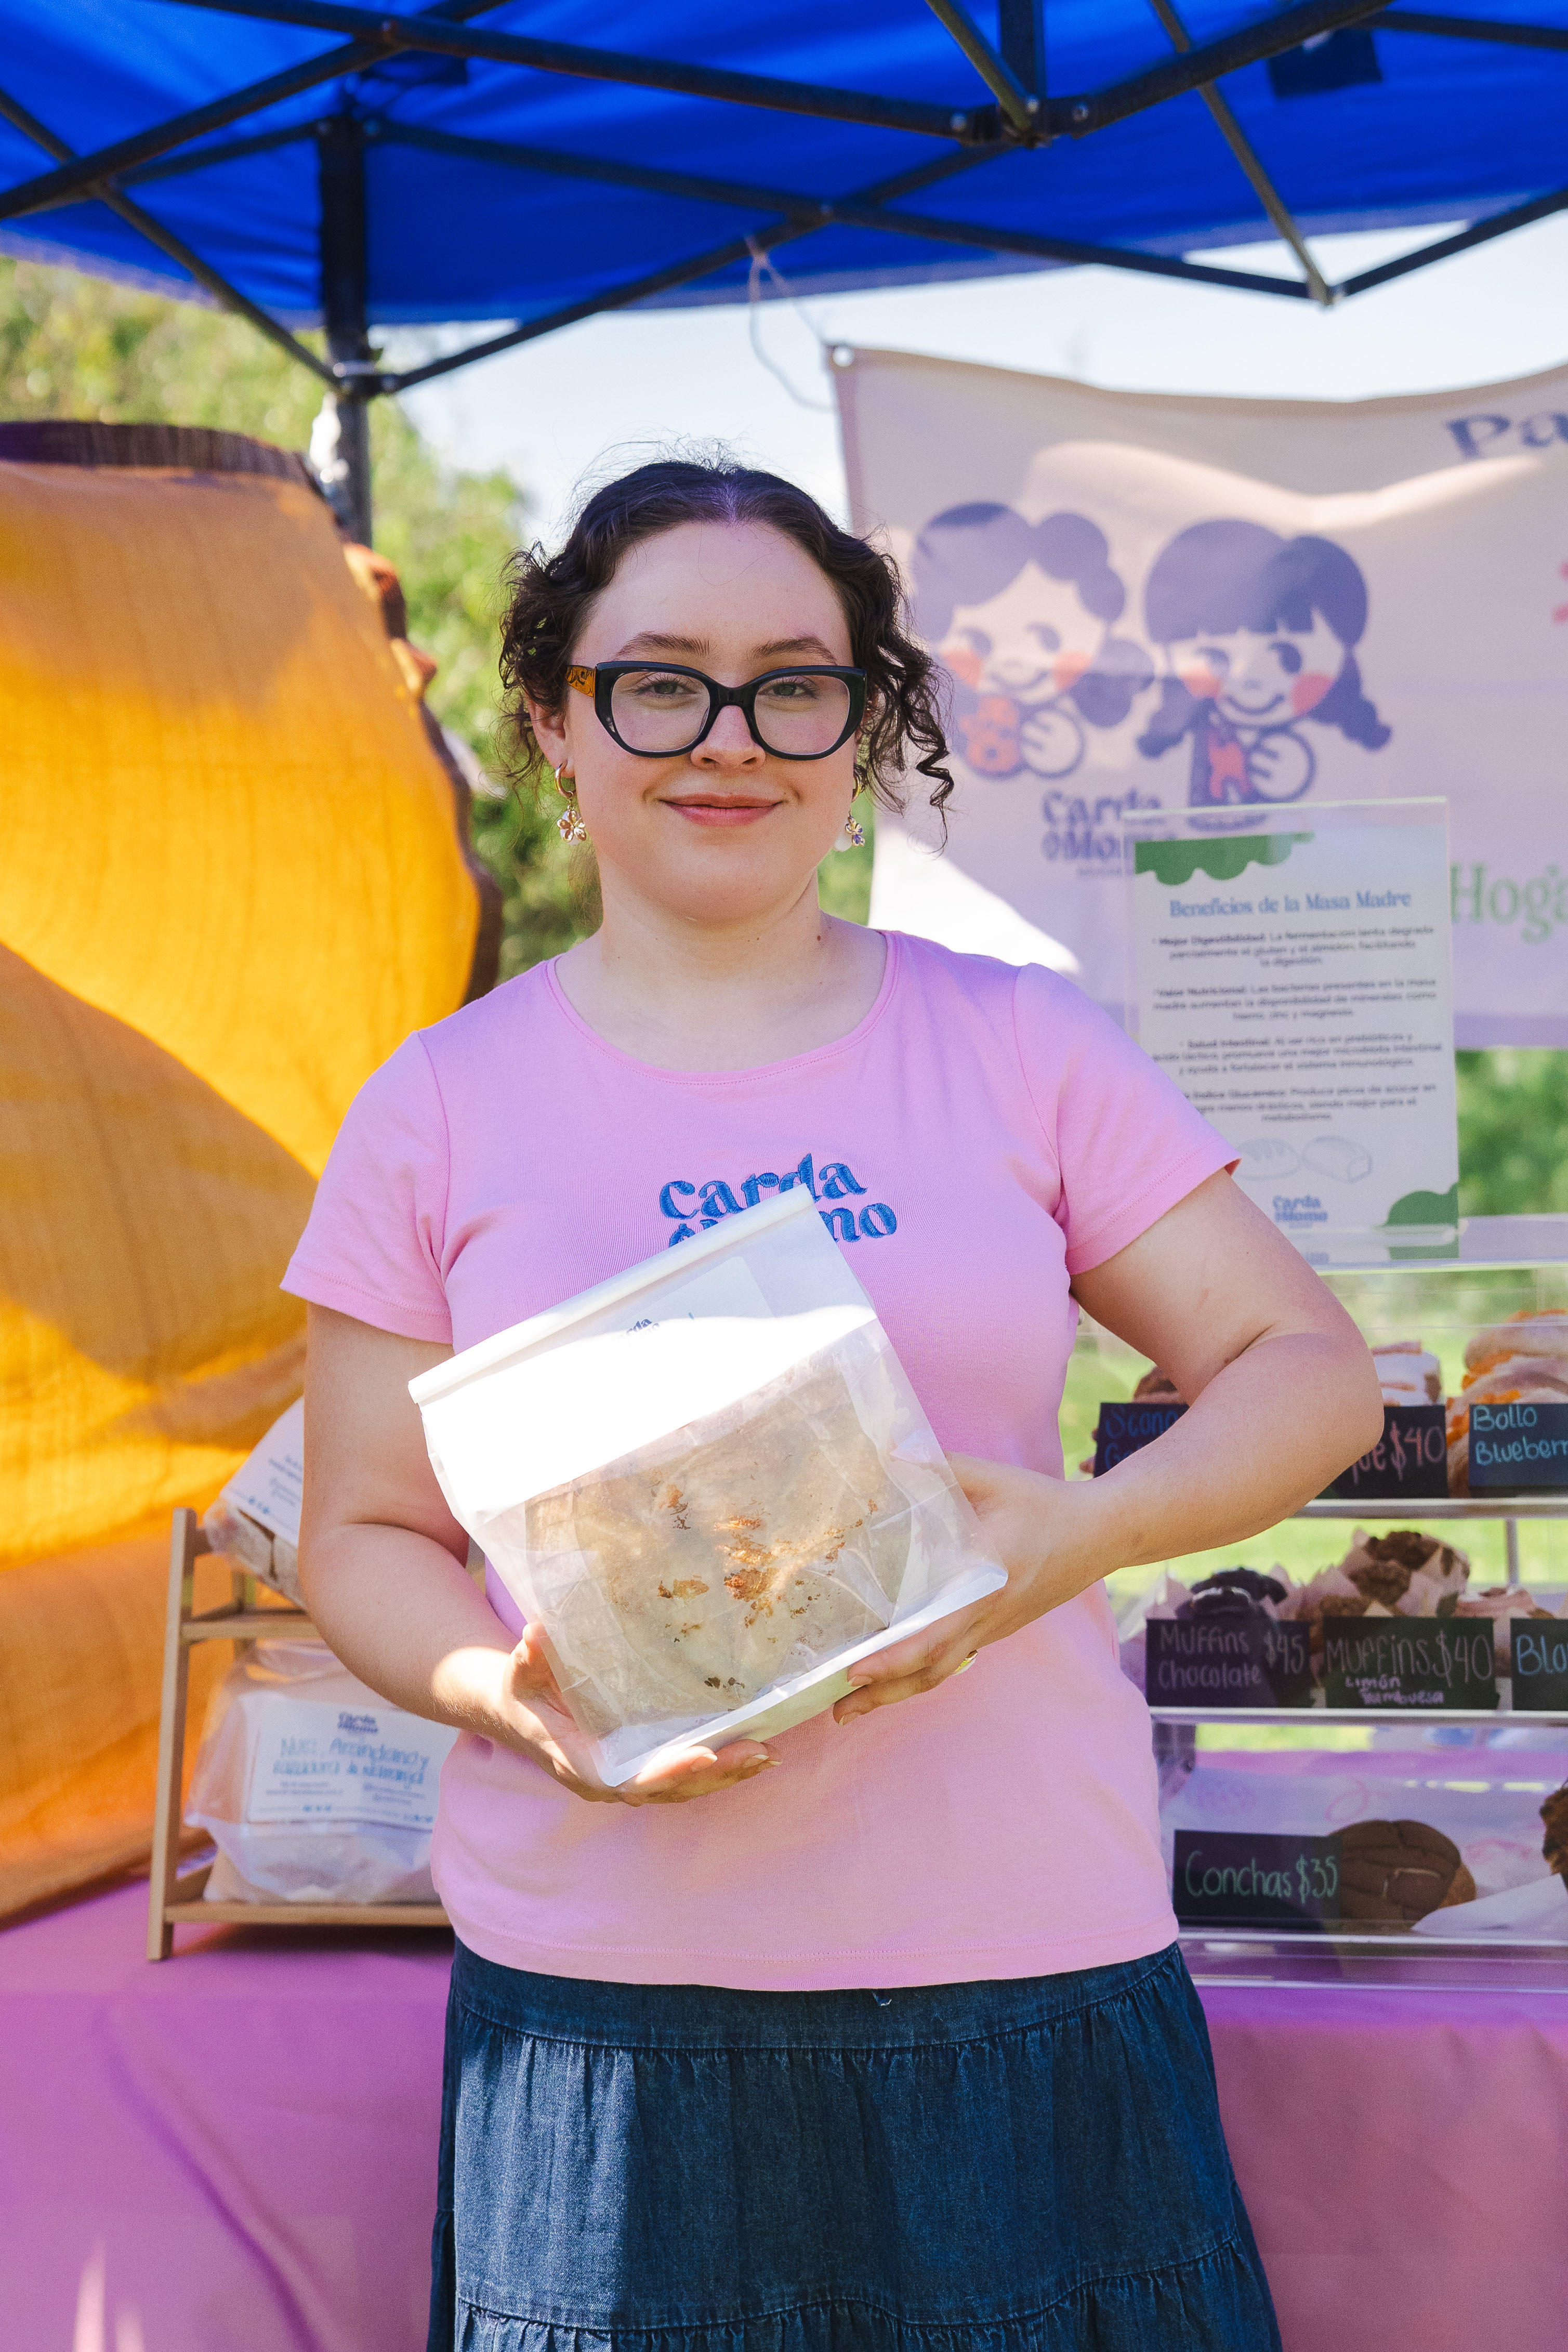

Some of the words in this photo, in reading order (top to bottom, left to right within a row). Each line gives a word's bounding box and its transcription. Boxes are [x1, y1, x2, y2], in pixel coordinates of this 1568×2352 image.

[1169, 898, 1253, 917] Beneficios
[1258, 896, 1279, 914] de
[1284, 893, 1299, 913] la
[1306, 893, 1350, 910] Masa
[1355, 890, 1411, 908] Madre
[659, 1153, 867, 1219] carda
[1473, 1404, 1538, 1431] Bollo
[1390, 1421, 1445, 1480] $40
[1158, 1660, 1263, 1690] Chocolate
[1432, 1630, 1493, 1689] $40
[1516, 1634, 1568, 1675] Blo
[1185, 1850, 1293, 1898] Conchas
[1296, 1852, 1339, 1905] $35
